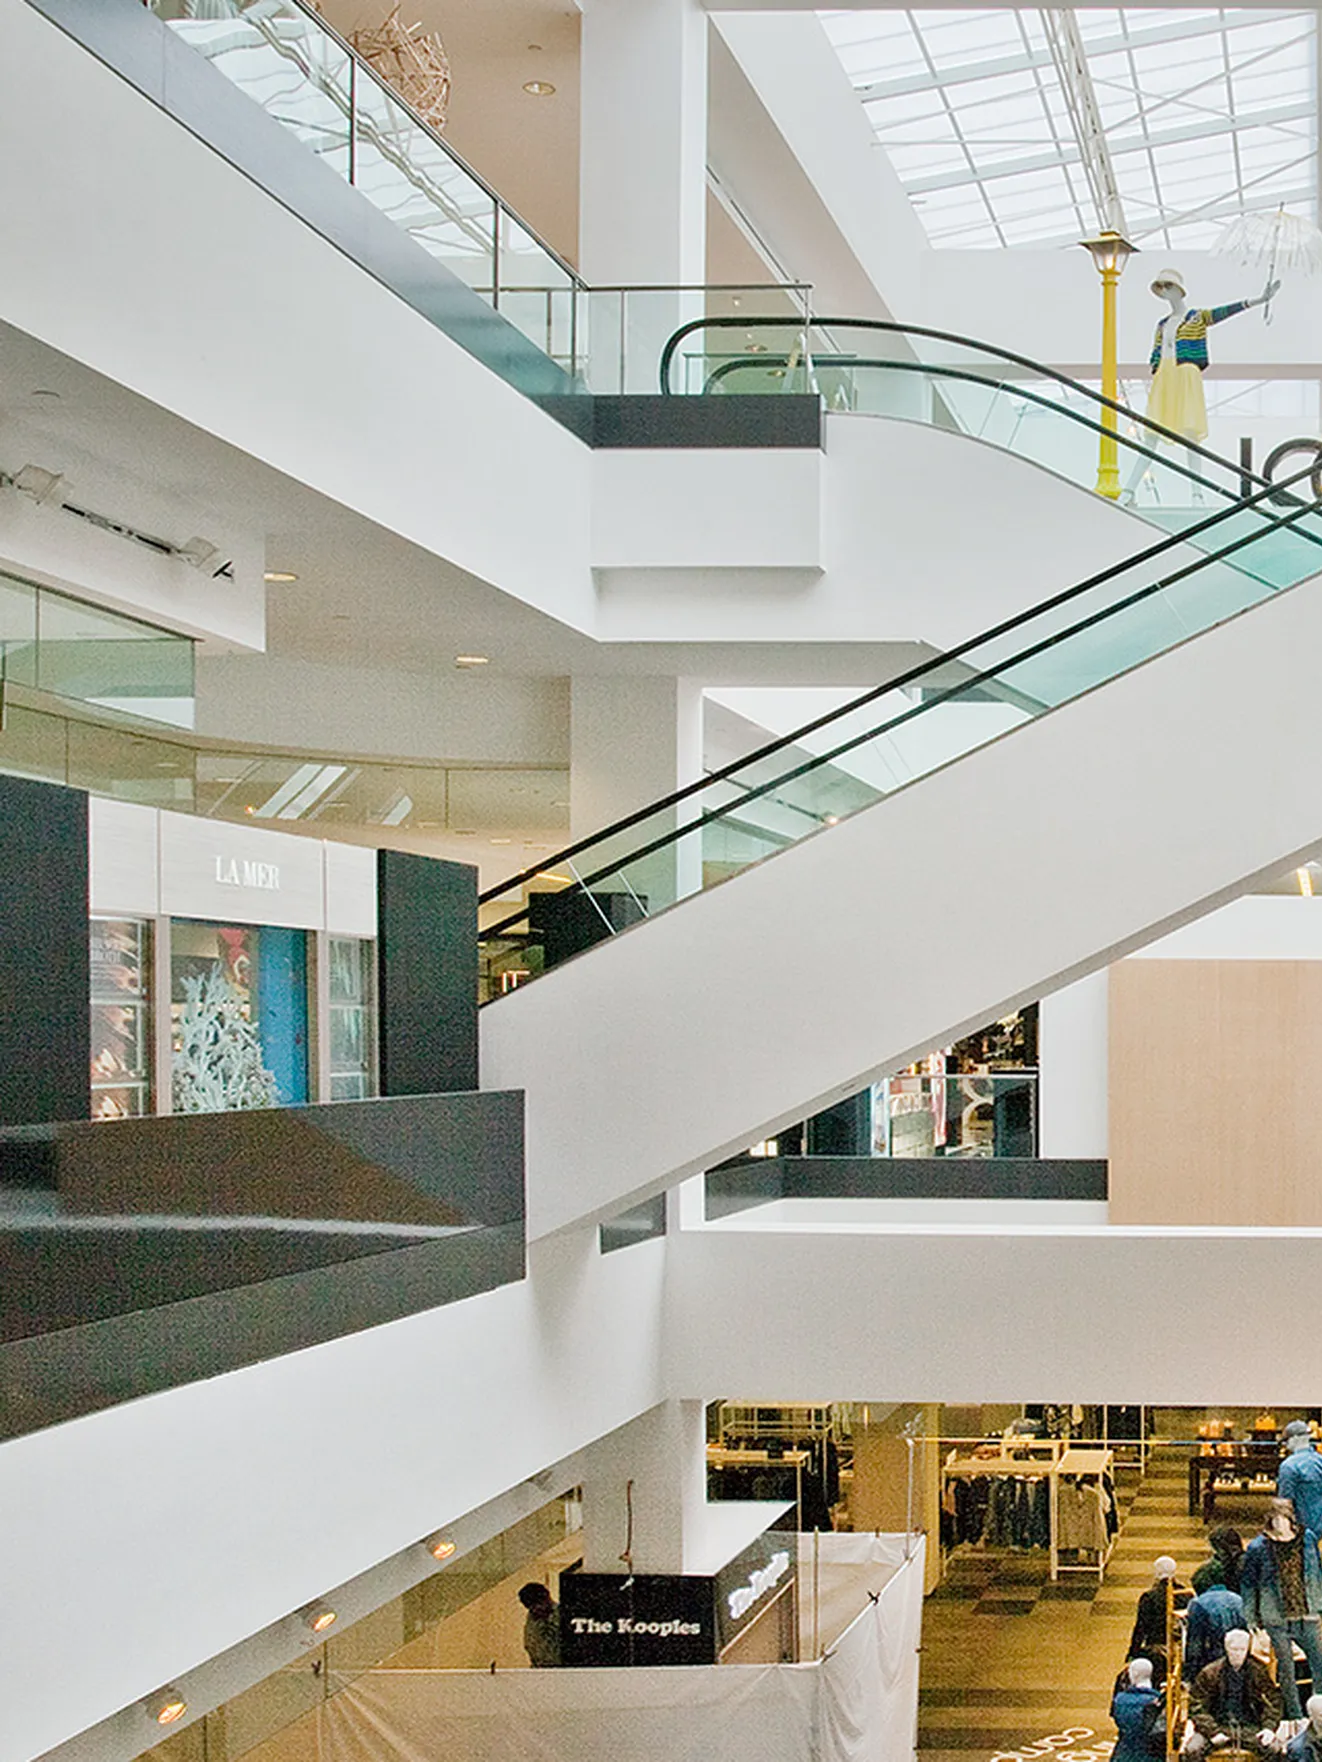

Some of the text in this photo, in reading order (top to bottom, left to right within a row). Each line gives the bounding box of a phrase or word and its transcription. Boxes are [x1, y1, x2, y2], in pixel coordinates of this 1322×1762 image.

[215, 855, 280, 889] LA MER
[570, 1617, 701, 1637] The Kooples
